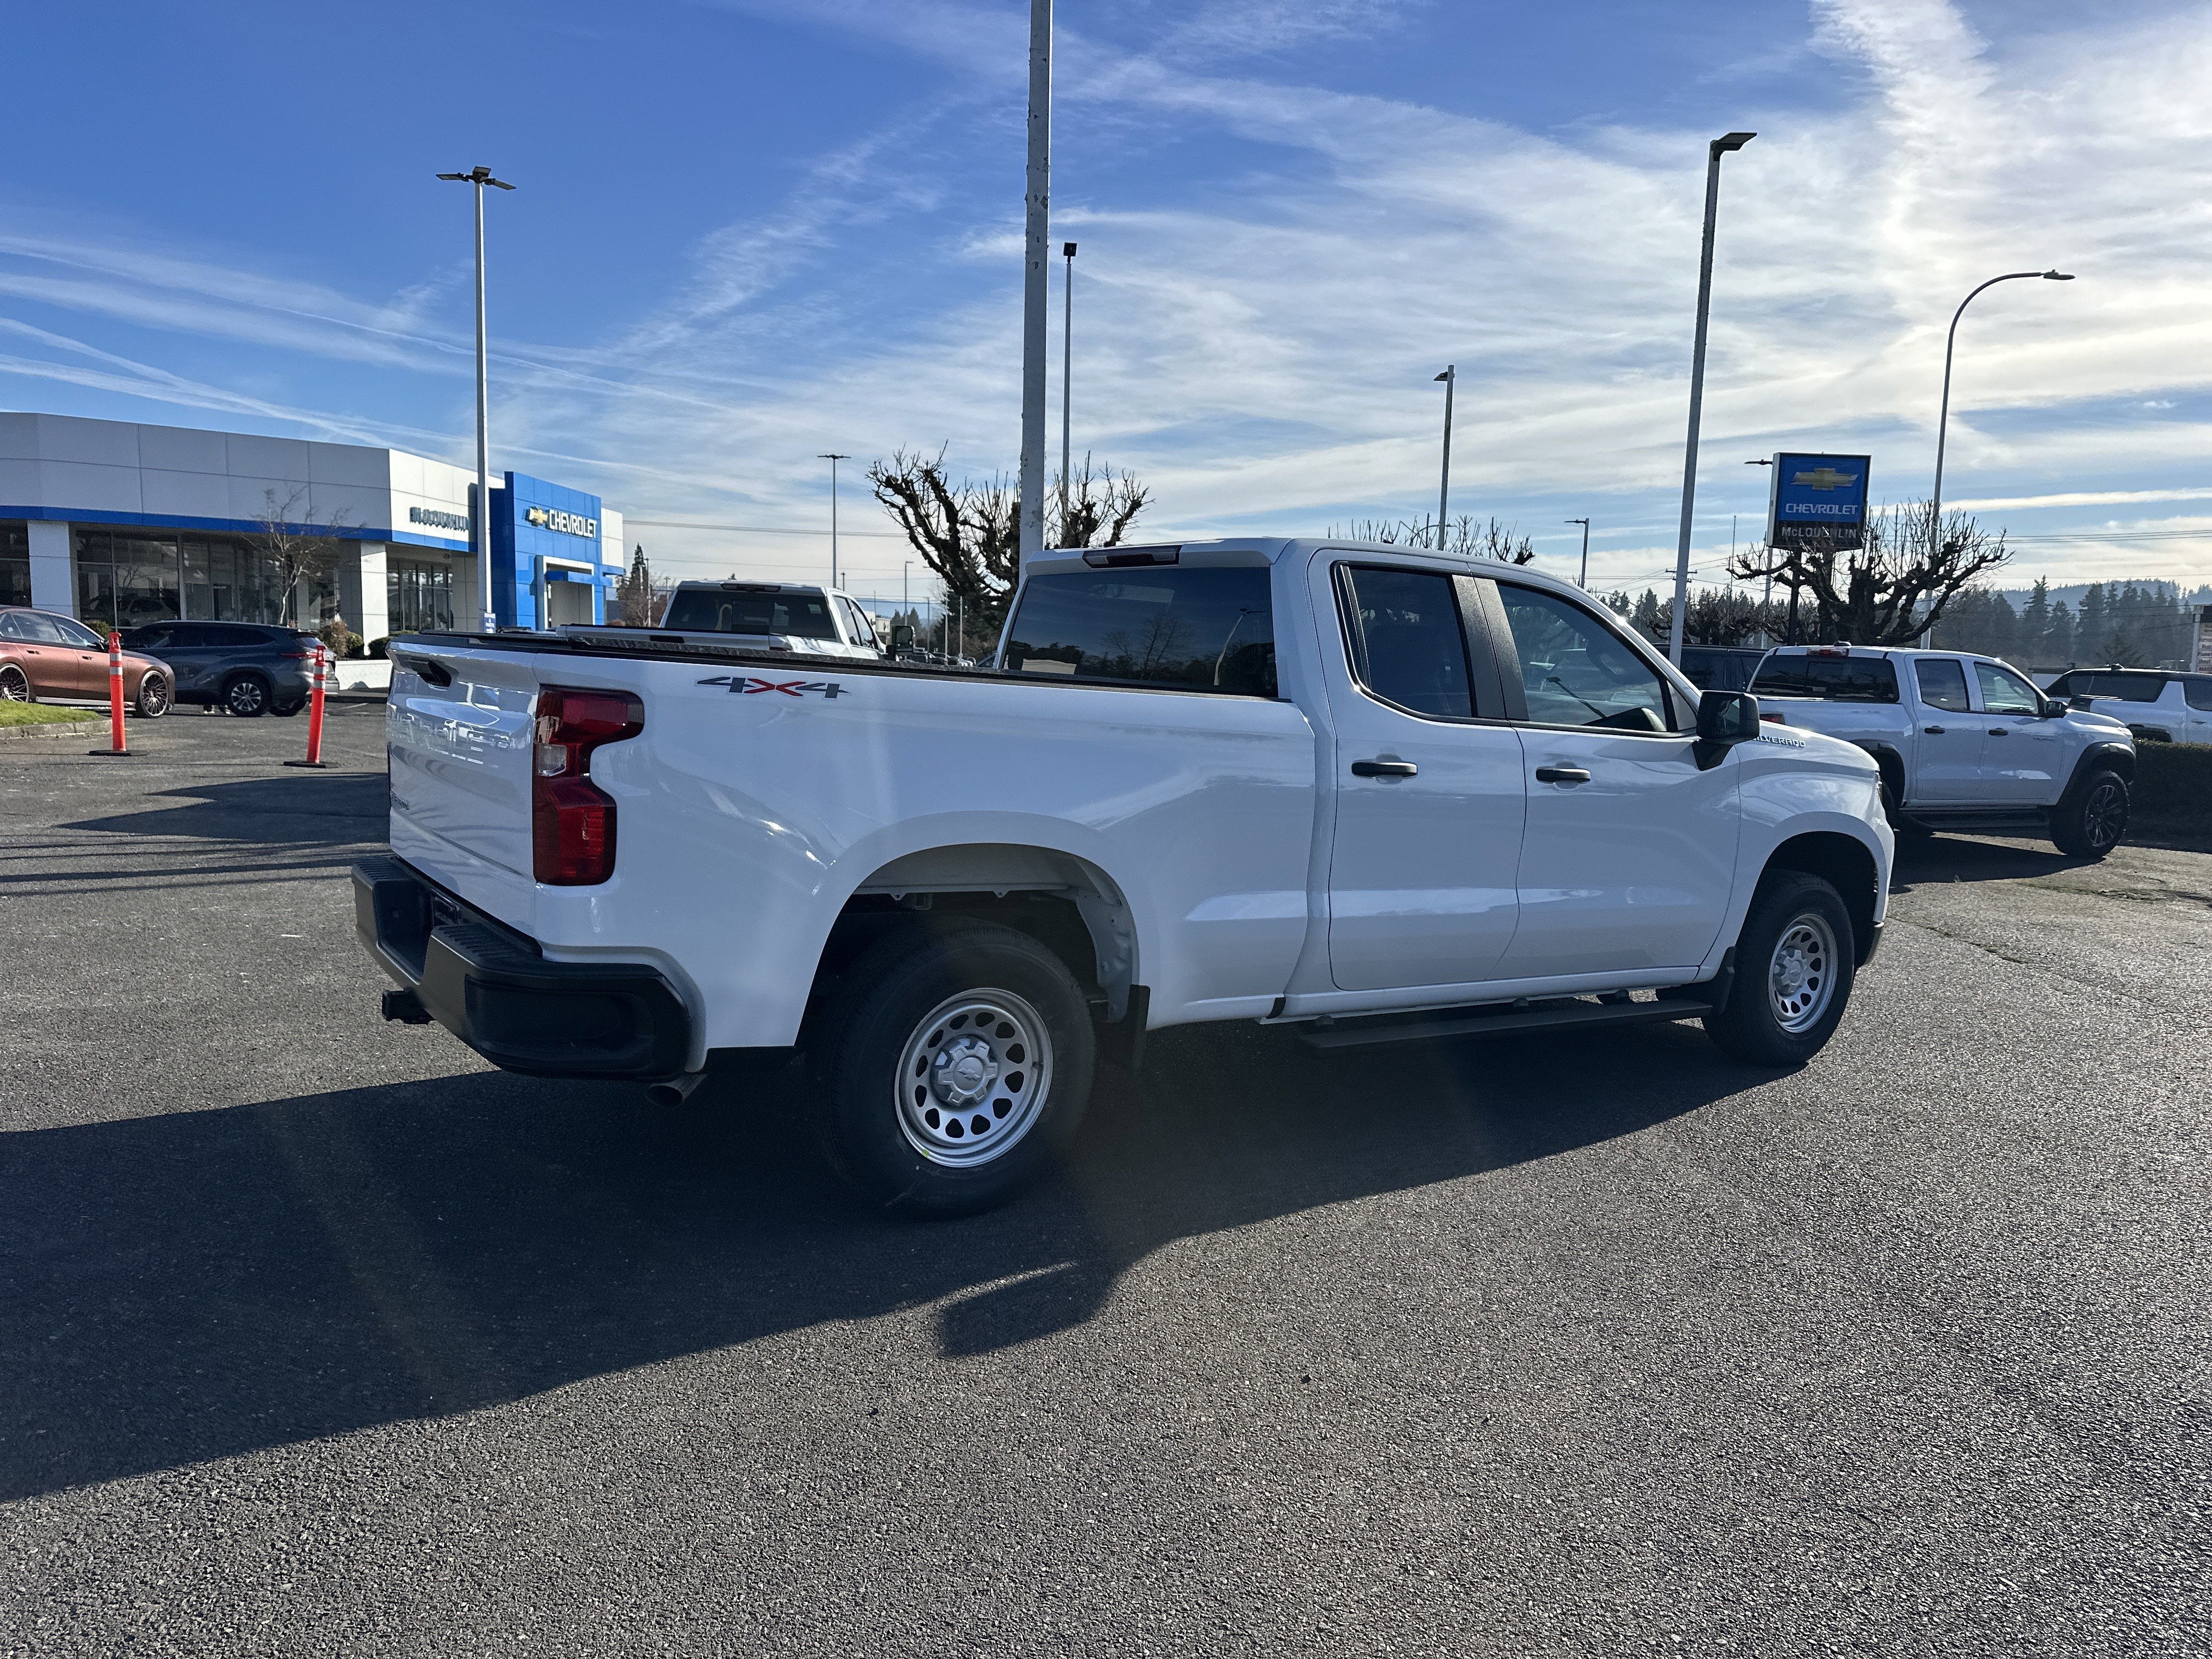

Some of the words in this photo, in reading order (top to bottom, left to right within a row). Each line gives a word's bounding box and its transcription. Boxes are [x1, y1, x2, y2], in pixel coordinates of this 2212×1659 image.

[1786, 503, 1858, 515] CHEVROLET
[549, 509, 597, 538] CHEVROLET
[1753, 735, 1806, 747] ILVERADO
